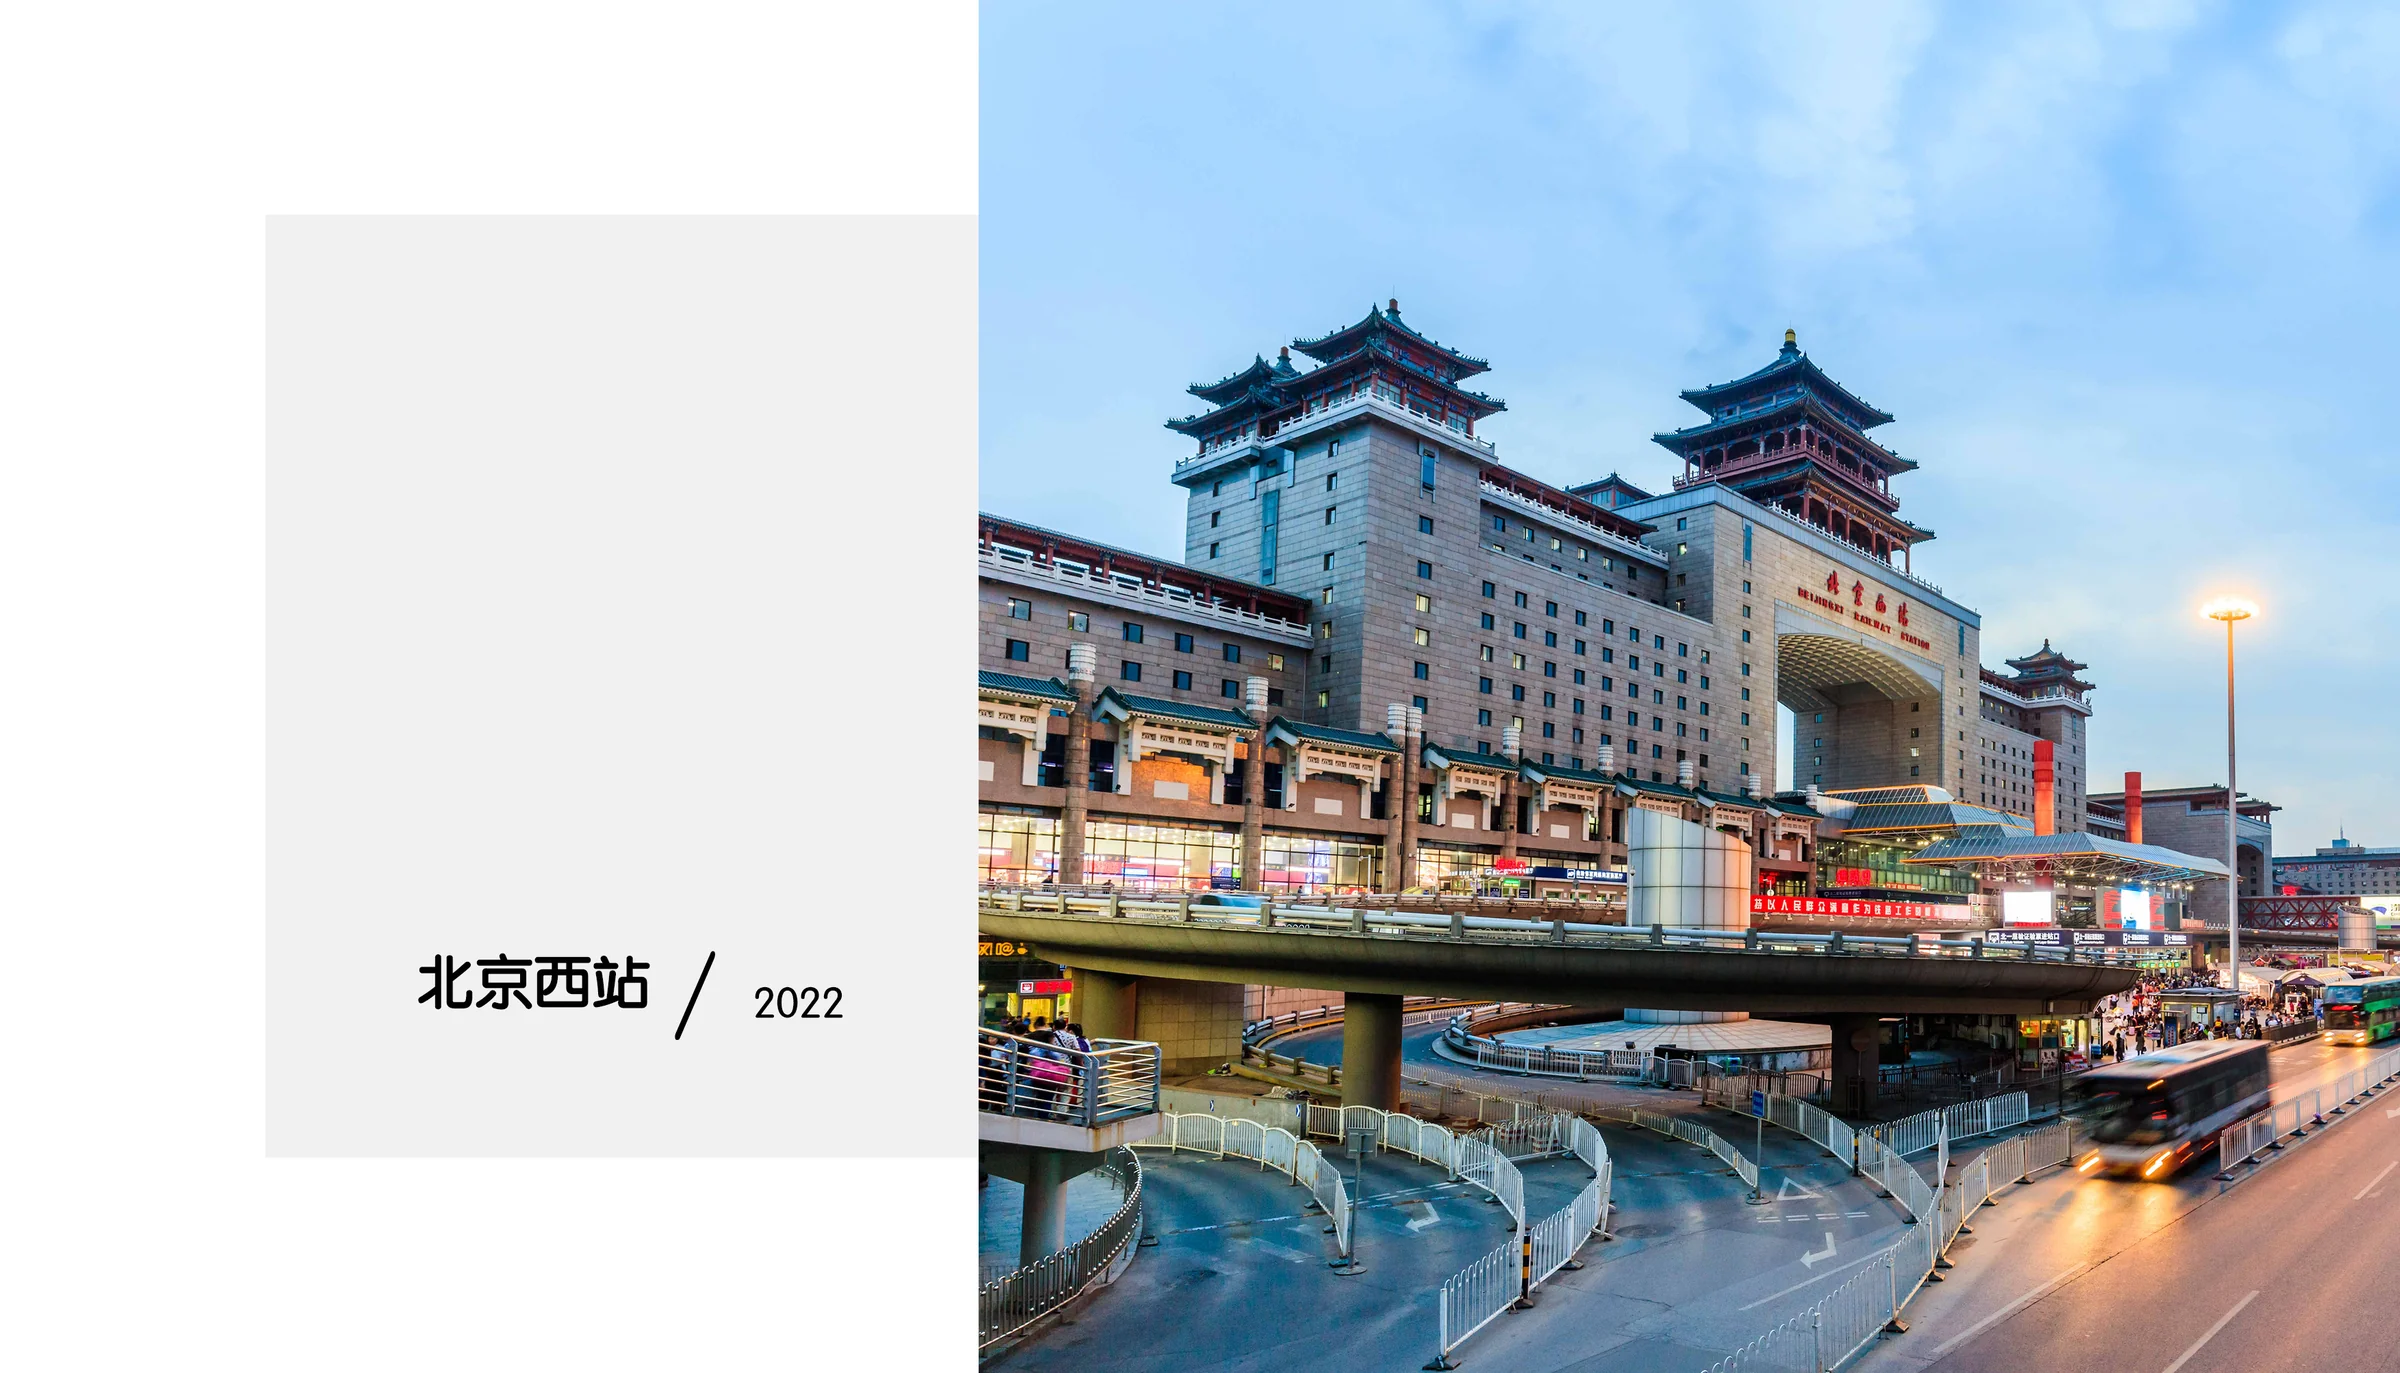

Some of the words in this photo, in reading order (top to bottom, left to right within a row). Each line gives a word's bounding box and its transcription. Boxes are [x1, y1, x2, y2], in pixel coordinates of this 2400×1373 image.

[1798, 587, 1844, 614] BEIJINGXI
[1854, 611, 1892, 634] RAILWAY
[1900, 631, 1930, 651] STATION
[1827, 570, 1910, 628] 北京西站
